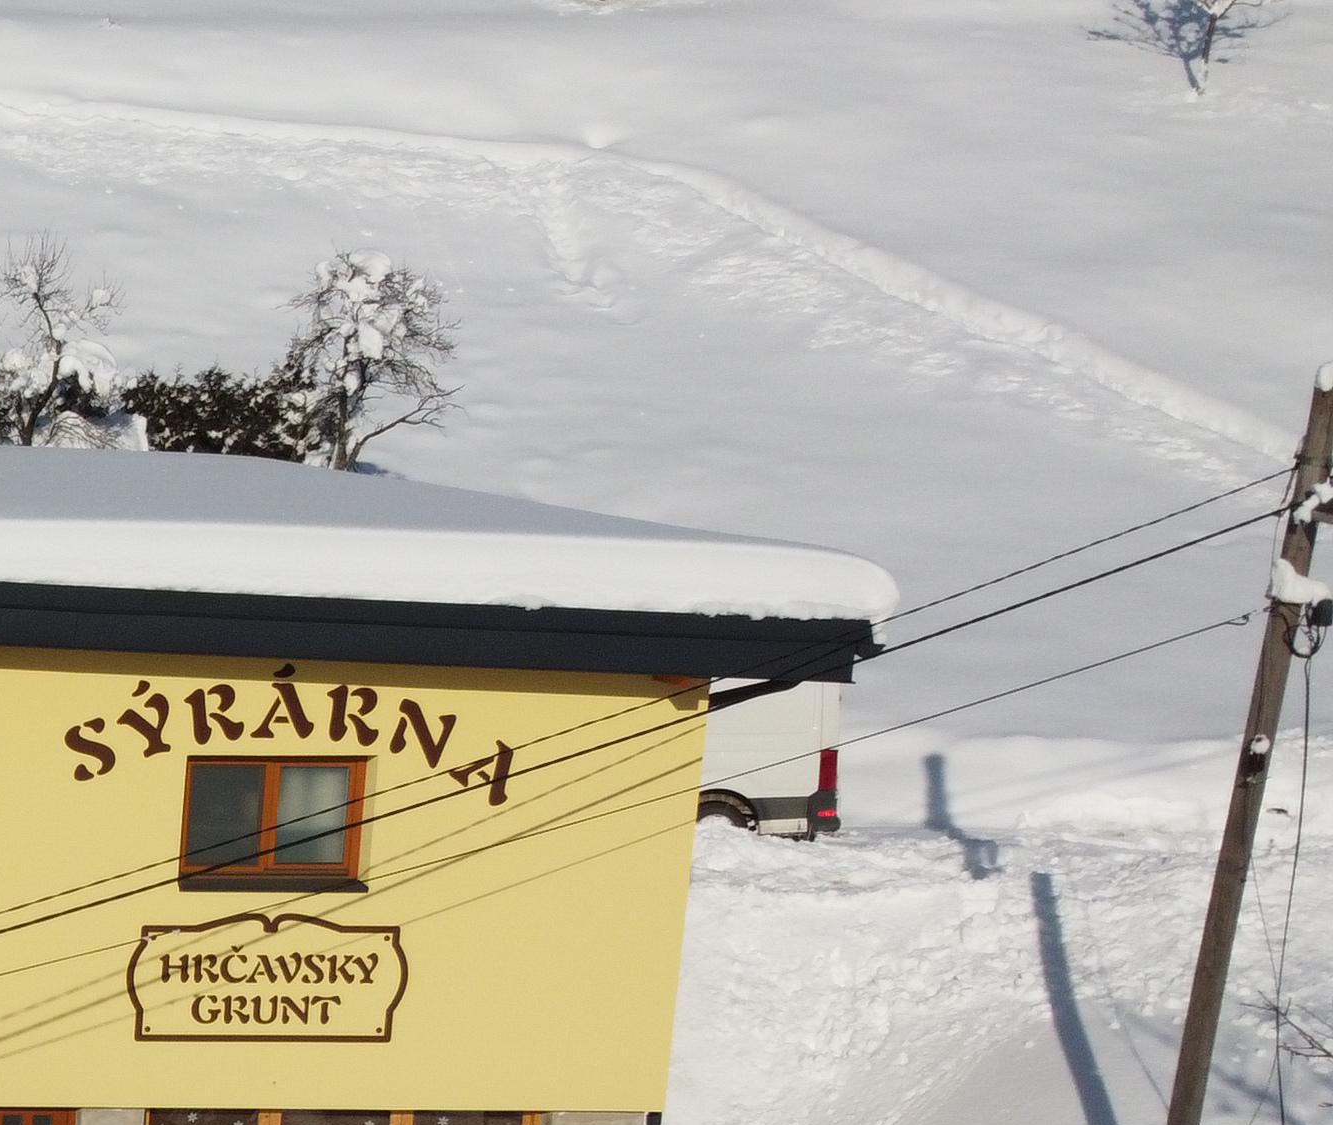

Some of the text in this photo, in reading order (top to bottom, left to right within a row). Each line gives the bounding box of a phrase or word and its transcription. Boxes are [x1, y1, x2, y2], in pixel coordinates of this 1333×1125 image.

[64, 664, 515, 806] SÝRÁRNA
[159, 945, 379, 984] HRČAVSKY
[190, 995, 342, 1025] GRUNT
